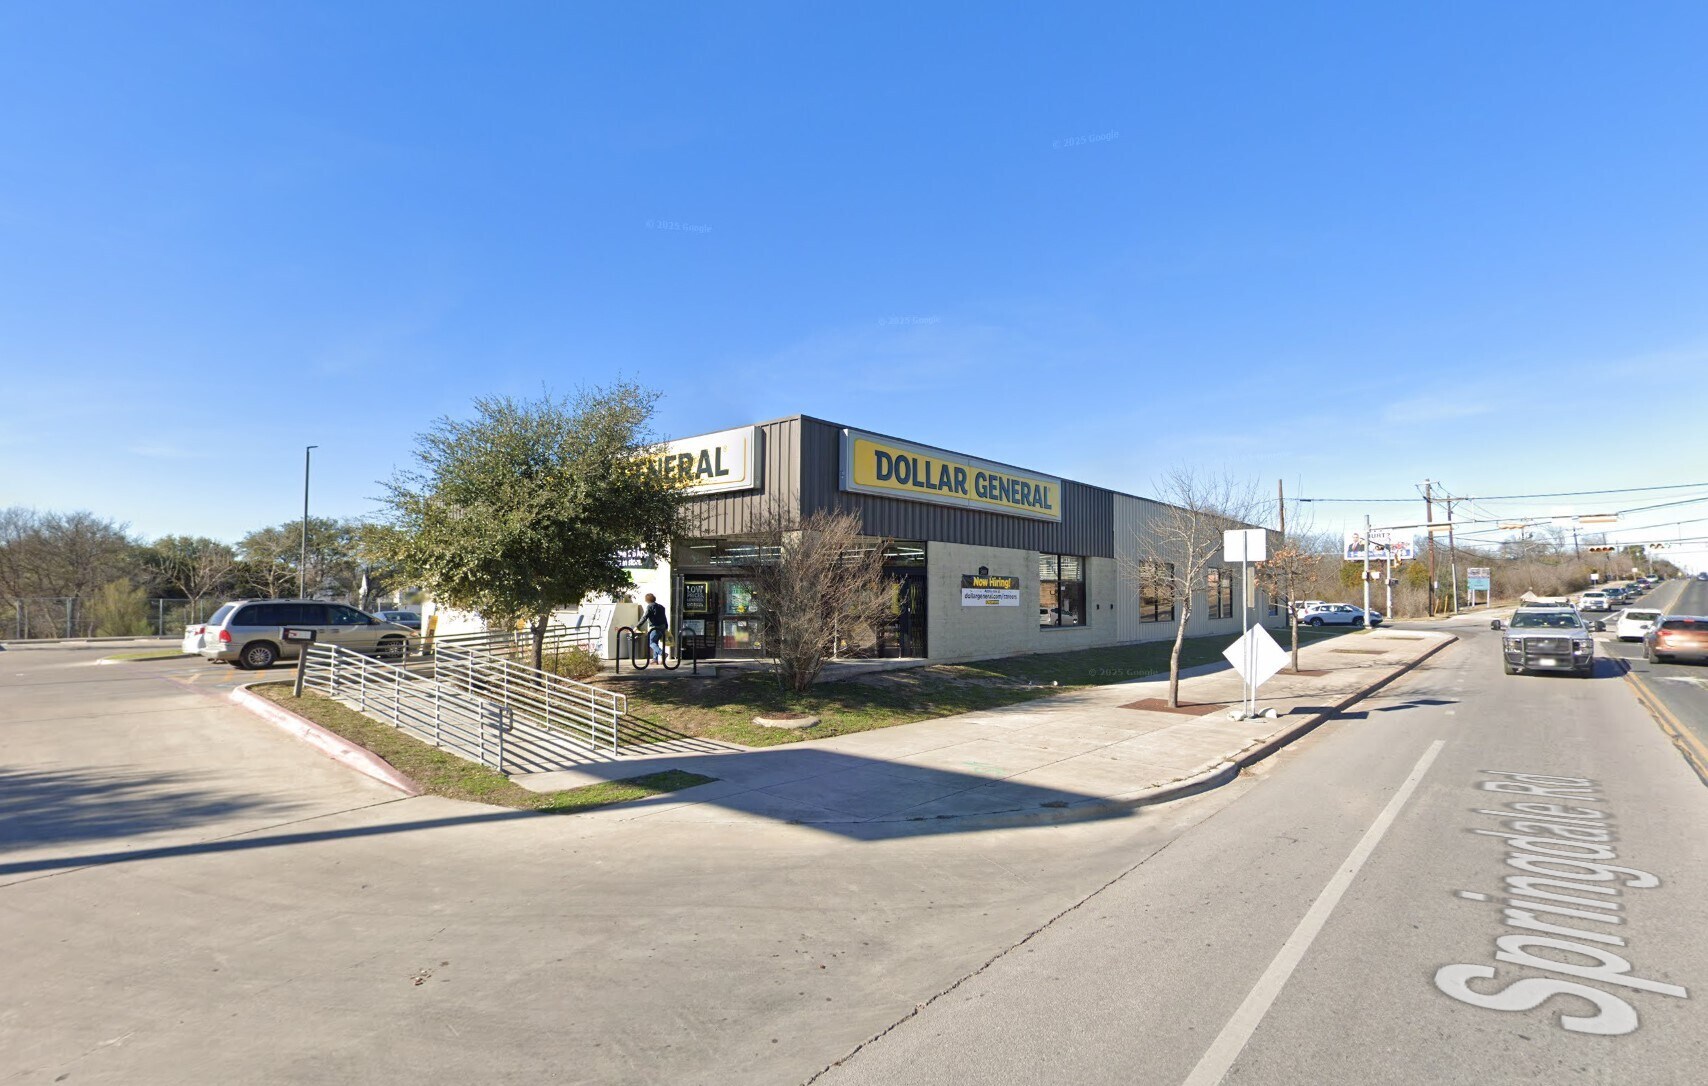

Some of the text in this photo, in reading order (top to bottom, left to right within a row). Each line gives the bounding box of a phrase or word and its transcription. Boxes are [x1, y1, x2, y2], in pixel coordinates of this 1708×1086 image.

[874, 449, 1053, 510] DOLLAR GENERAL
[687, 585, 703, 593] LOW
[973, 576, 1011, 589] Now Hiring!
